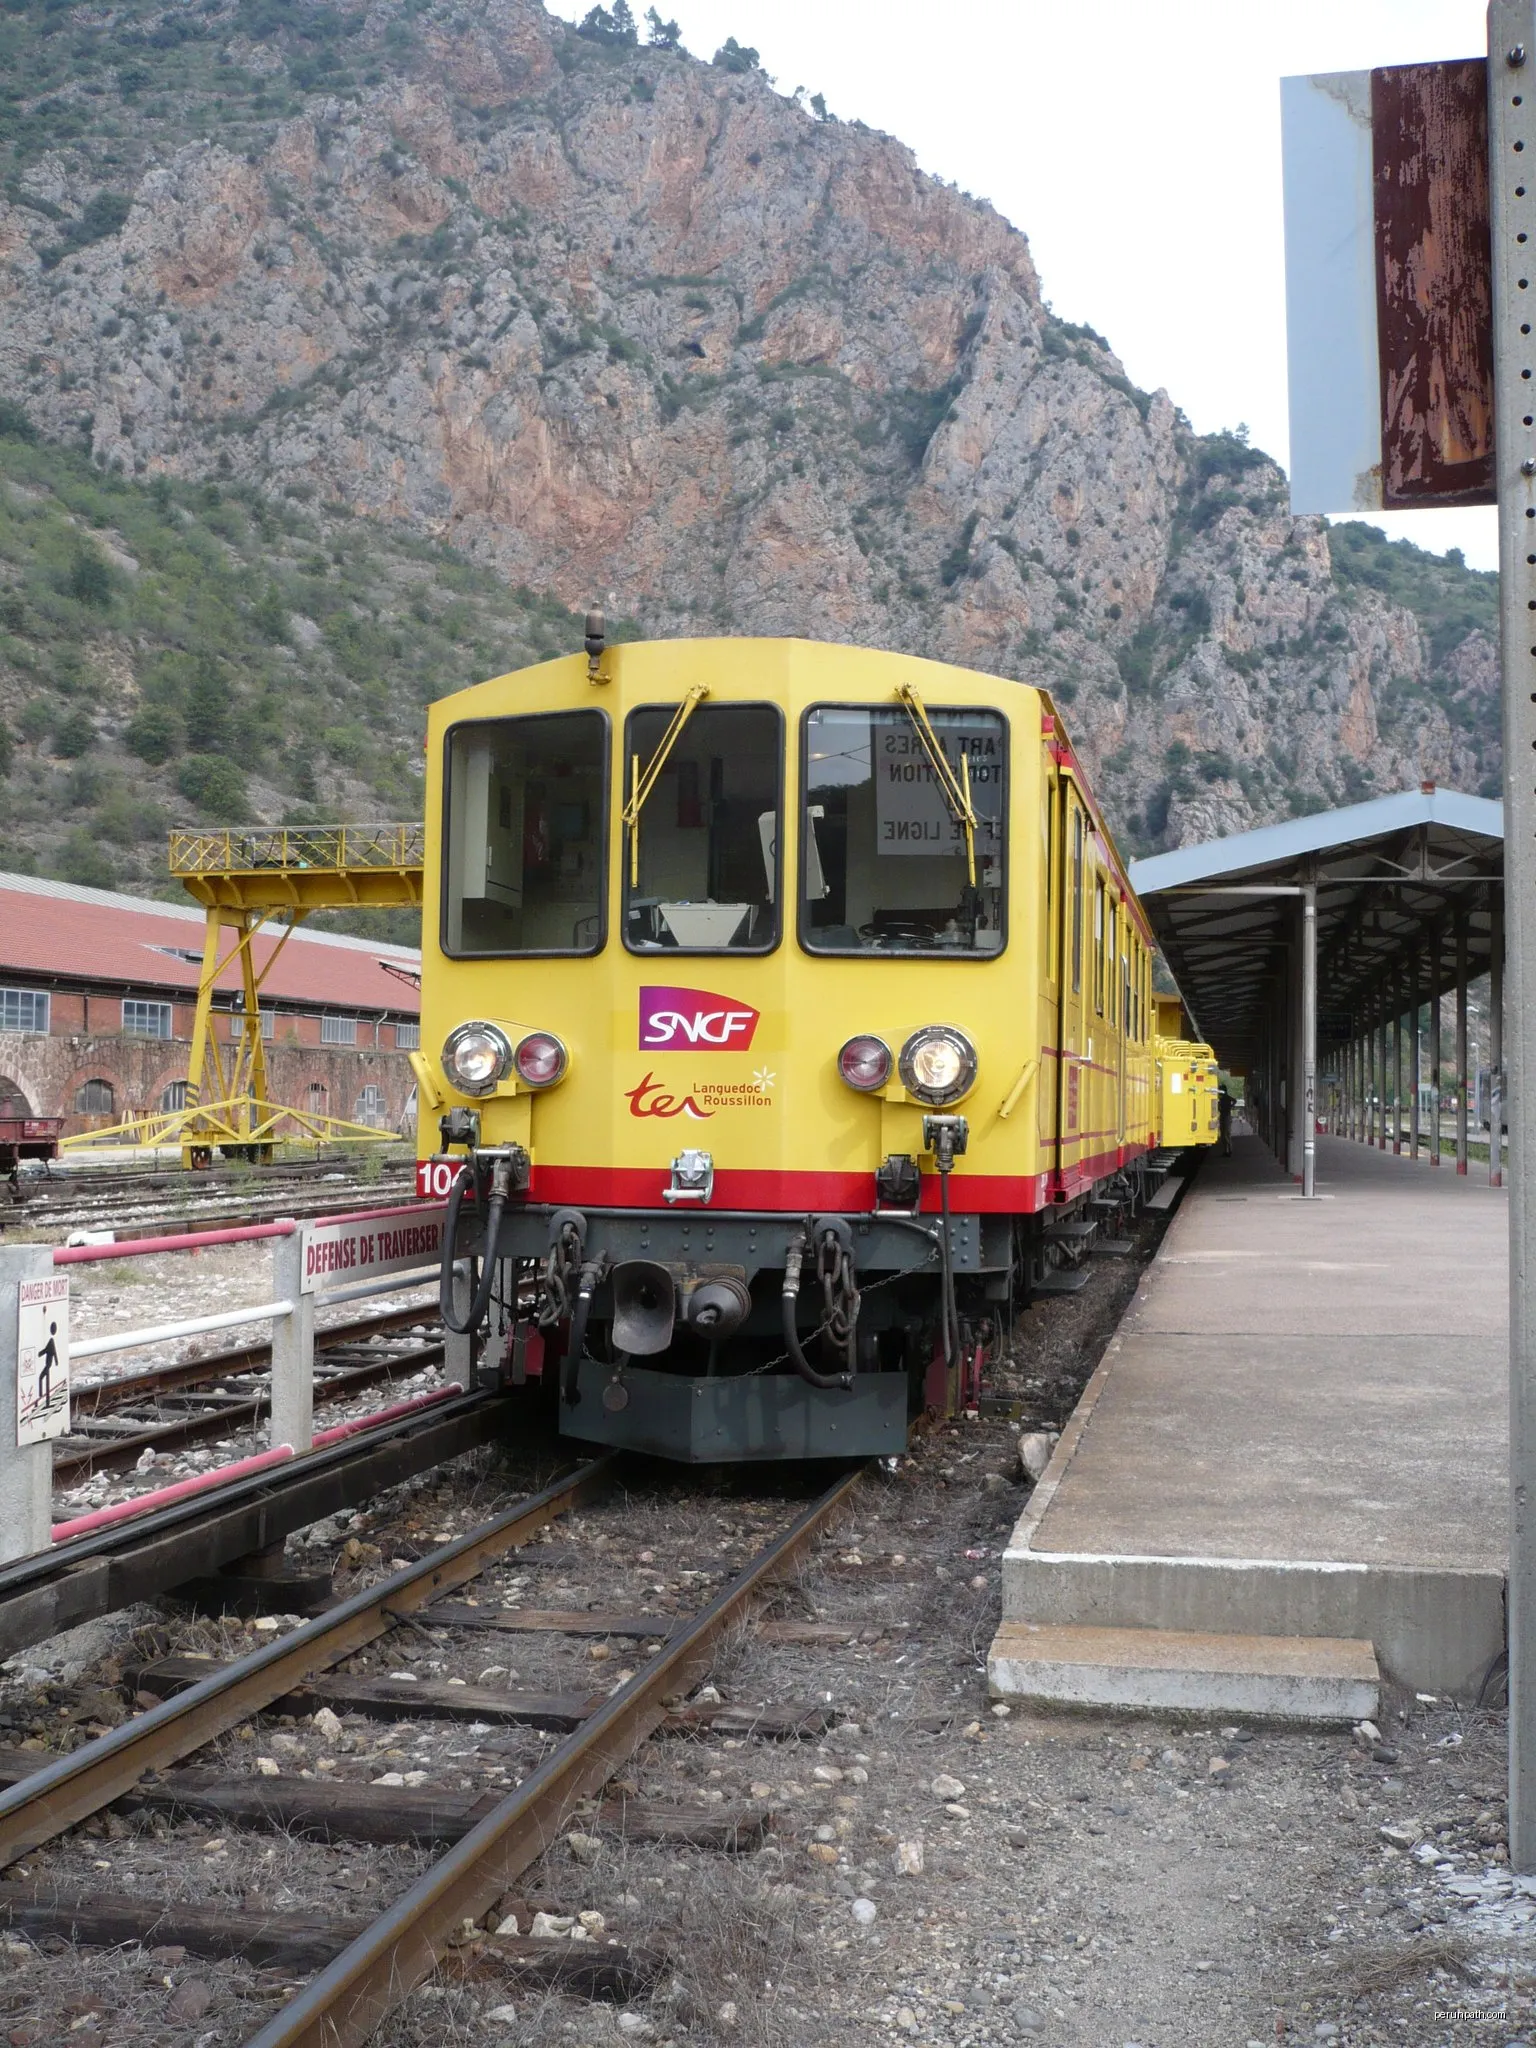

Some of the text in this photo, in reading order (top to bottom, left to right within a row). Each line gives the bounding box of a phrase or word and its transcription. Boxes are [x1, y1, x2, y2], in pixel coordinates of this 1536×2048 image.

[644, 1011, 753, 1043] SNCF
[624, 1071, 716, 1119] ter
[693, 1082, 761, 1096] Languedoc
[703, 1095, 772, 1106] Roussillon
[306, 1237, 356, 1276] DEFENSE
[360, 1232, 374, 1265] DE
[378, 1224, 438, 1261] TRAVERSER
[22, 1278, 68, 1301] DANGER DE MORT
